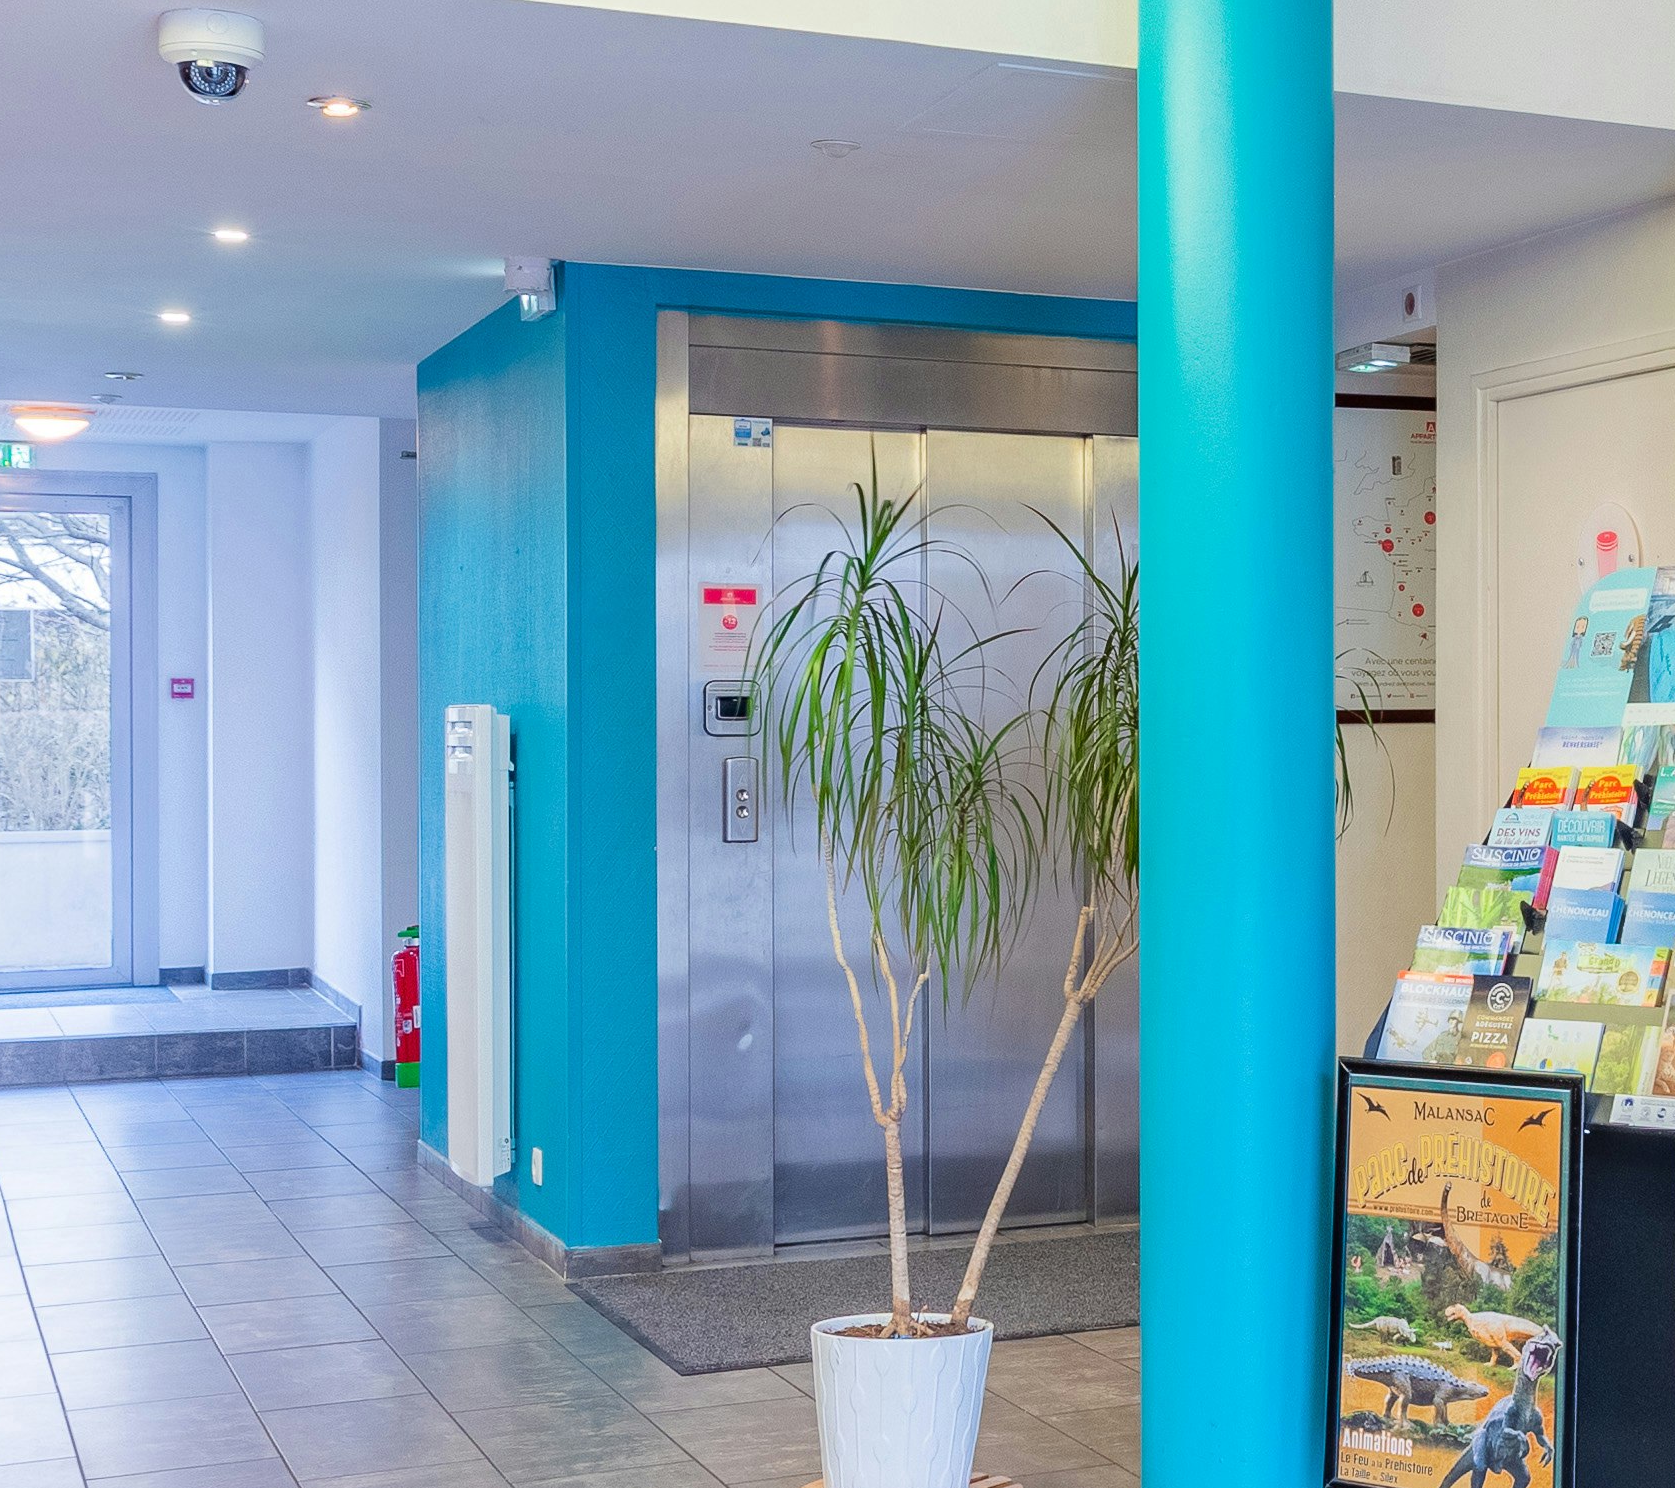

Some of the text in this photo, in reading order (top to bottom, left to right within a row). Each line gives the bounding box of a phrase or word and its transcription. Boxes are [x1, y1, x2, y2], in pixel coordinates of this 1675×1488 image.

[1496, 828, 1541, 837] DES VINS
[1471, 847, 1541, 862] SUSCINIO
[1423, 929, 1495, 945] SUSCINIO
[1470, 1031, 1509, 1045] PIZZA
[1407, 1157, 1424, 1186] de
[1419, 1128, 1556, 1227] PRÉHISTOIRE
[1480, 1191, 1491, 1208] de
[1456, 1207, 1529, 1229] BRETAGNE
[1342, 1427, 1413, 1457] Animations
[1340, 1451, 1350, 1463] Le
[1353, 1453, 1369, 1466] Feu
[1340, 1466, 1349, 1477] La
